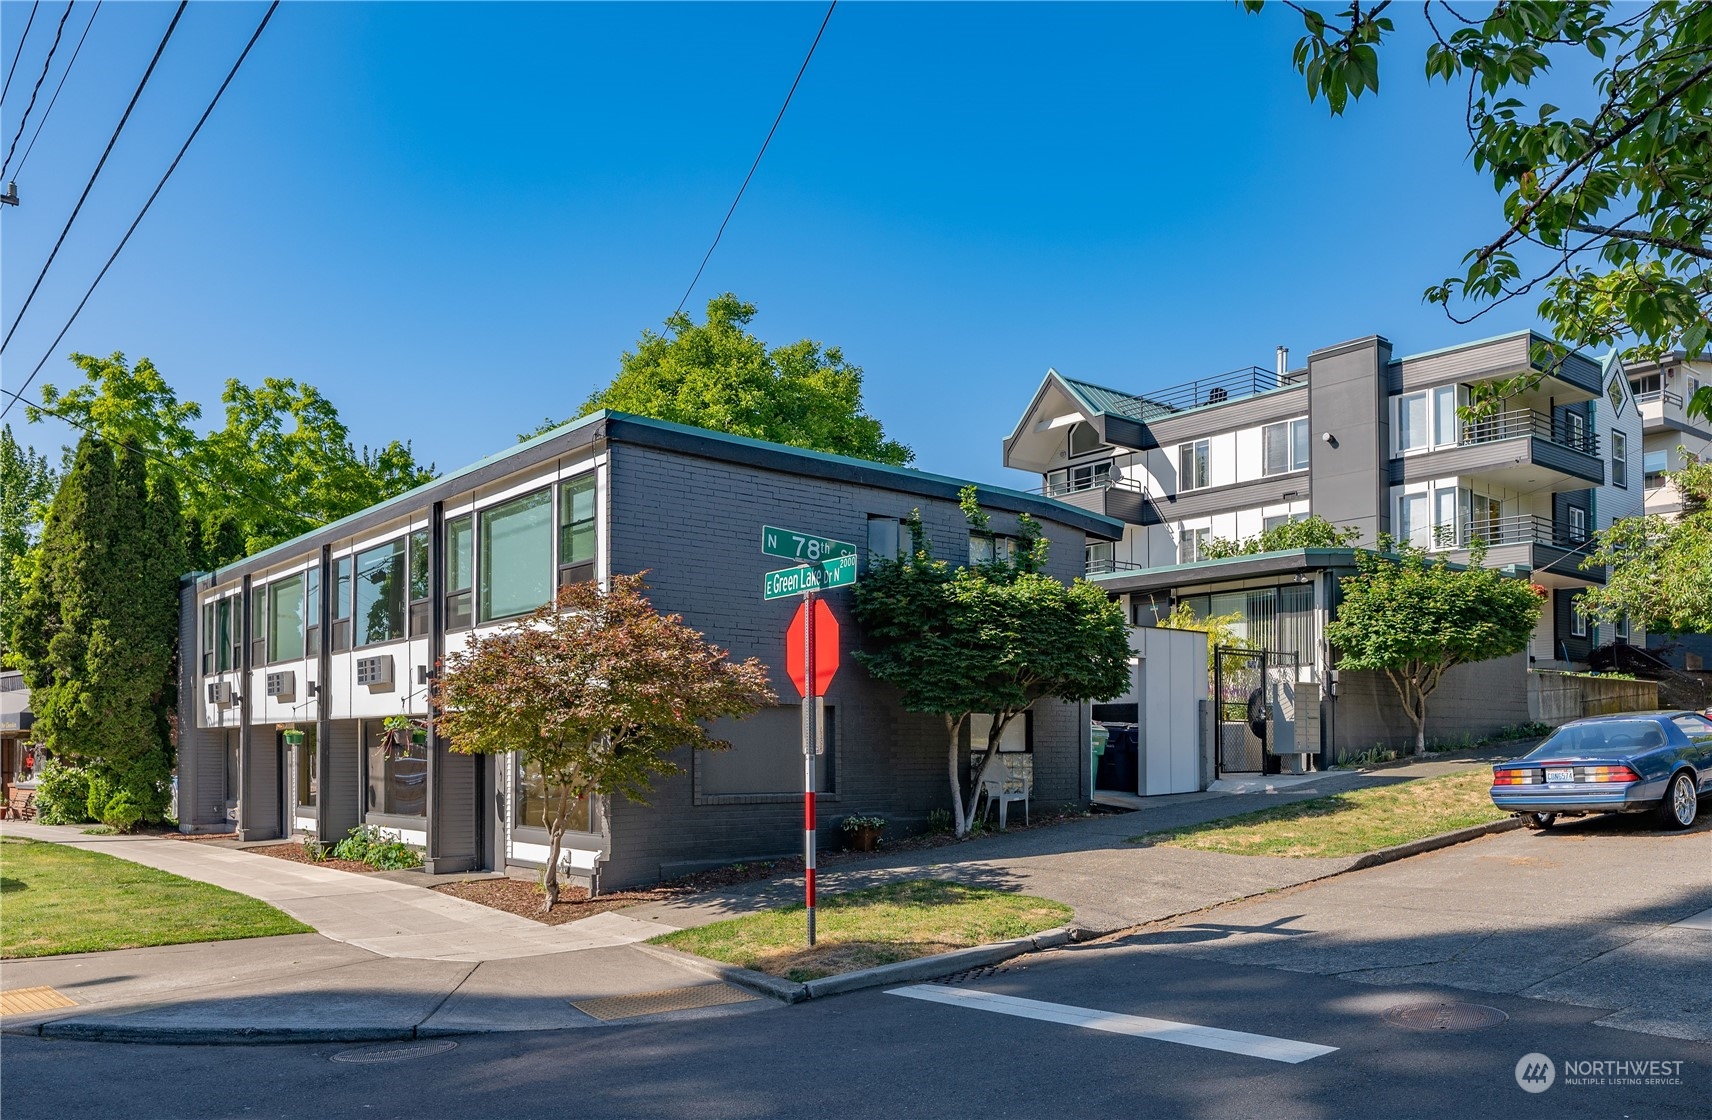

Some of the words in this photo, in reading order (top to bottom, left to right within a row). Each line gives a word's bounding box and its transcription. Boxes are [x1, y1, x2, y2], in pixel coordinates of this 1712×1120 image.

[768, 534, 777, 549] N
[792, 536, 830, 560] 78th
[840, 557, 855, 568] 2000
[767, 581, 773, 594] E
[773, 574, 798, 593] Green
[800, 567, 821, 589] Lake
[823, 570, 832, 584] Dr
[834, 567, 840, 582] N
